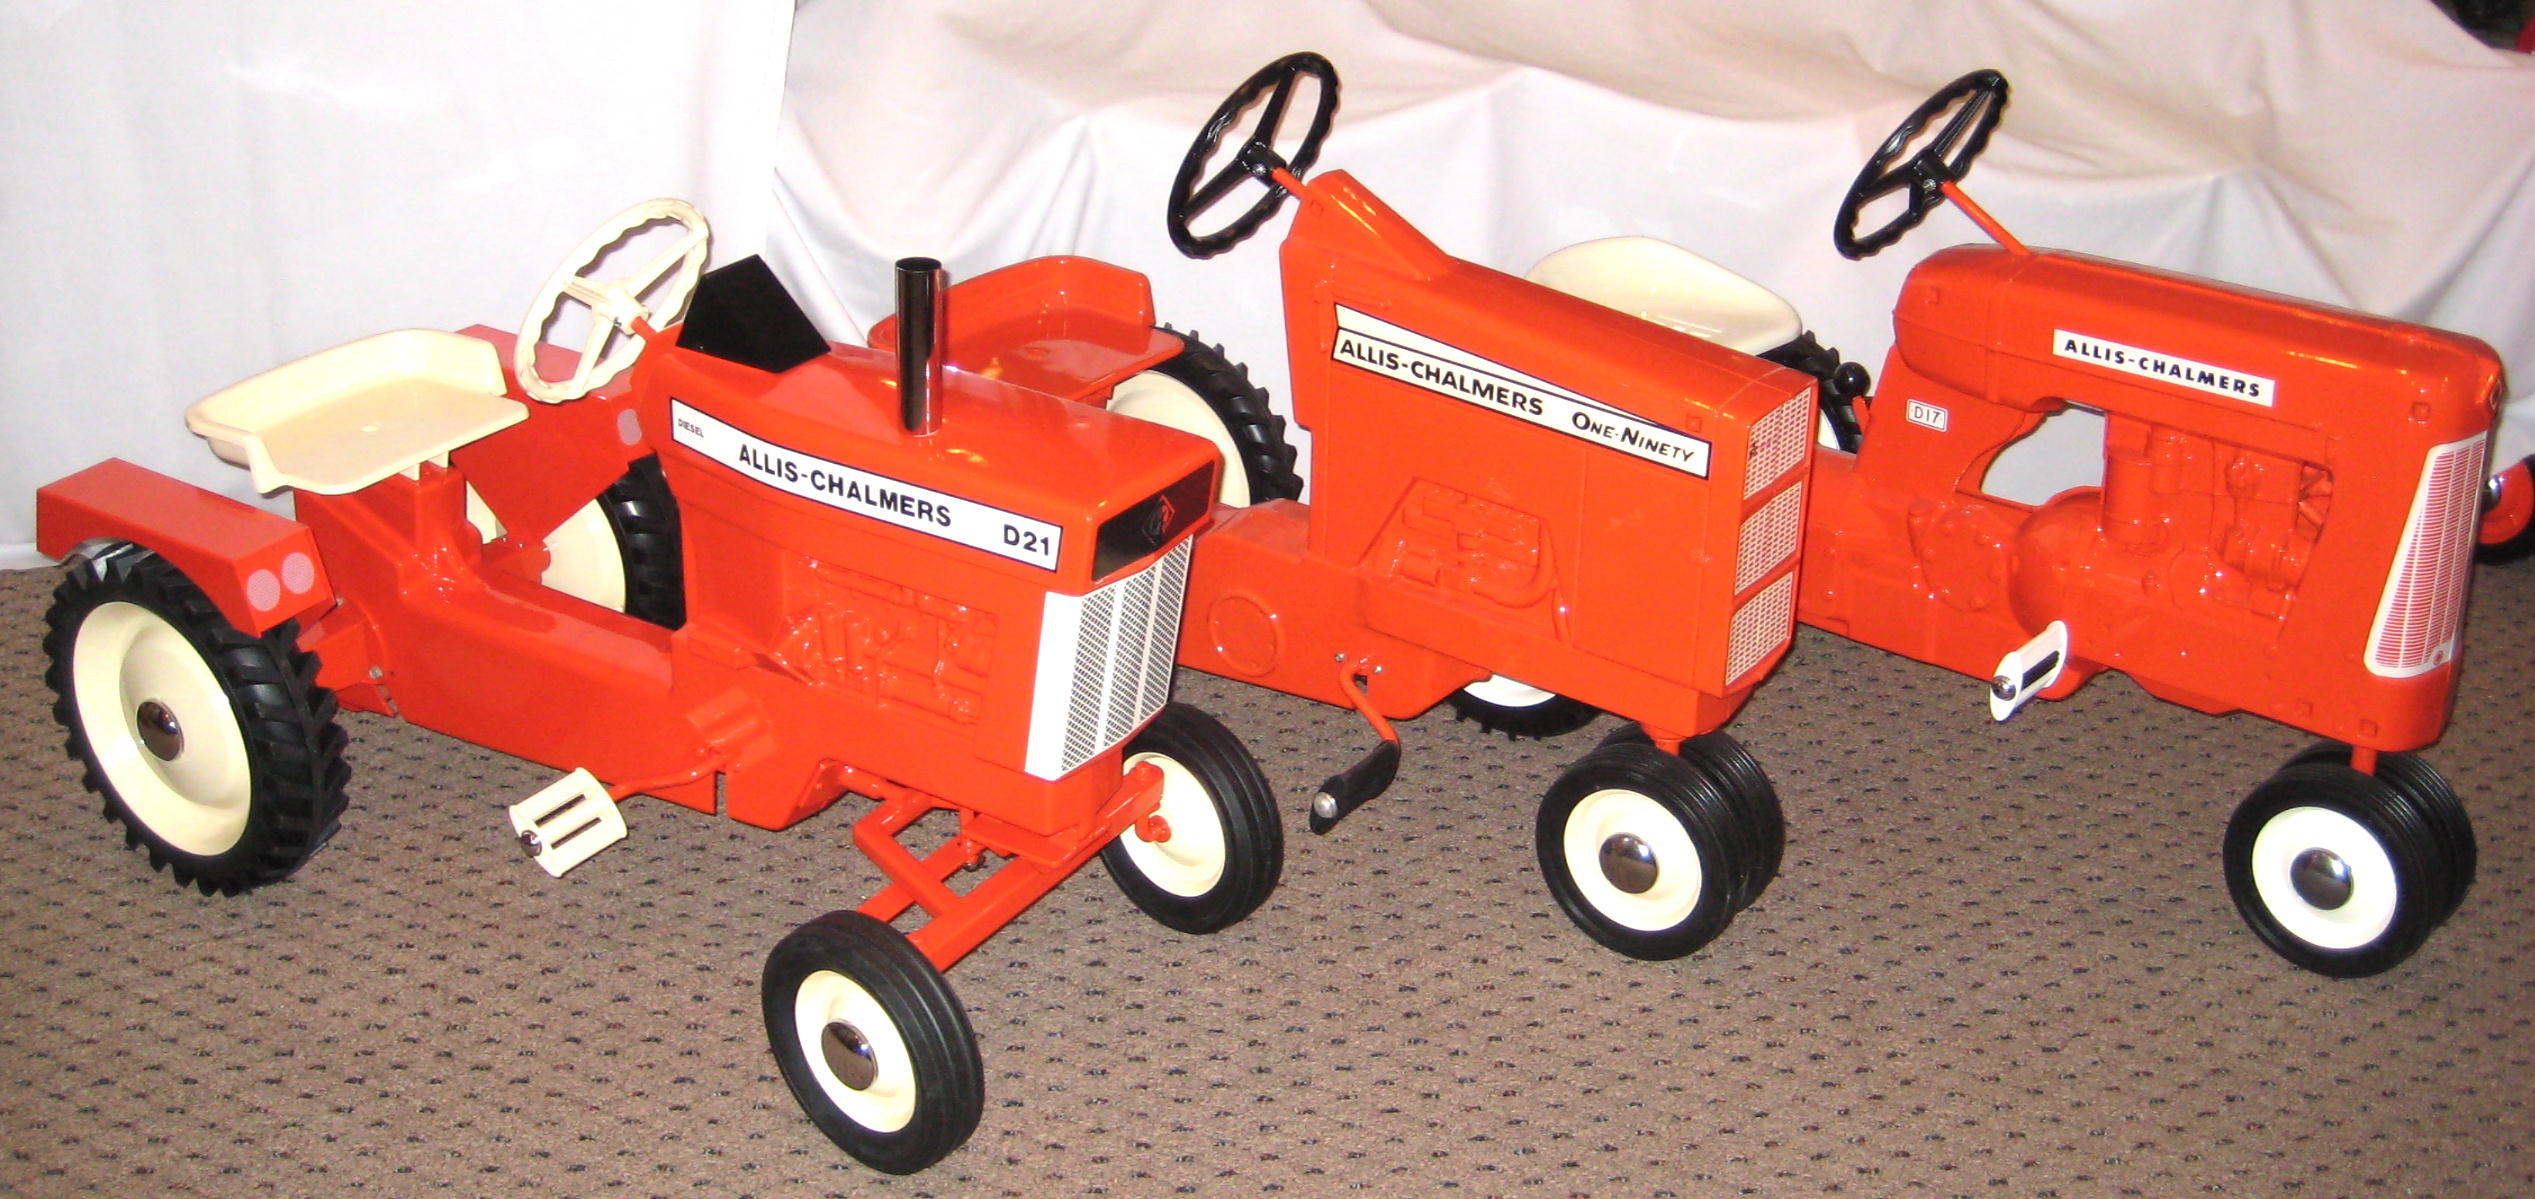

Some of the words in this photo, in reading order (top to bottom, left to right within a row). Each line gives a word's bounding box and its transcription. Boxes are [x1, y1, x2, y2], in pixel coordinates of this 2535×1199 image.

[1339, 338, 1544, 416] ALLIS-CHALMERS
[2064, 338, 2261, 398] ALLIS-CHALMERS
[1914, 405, 1941, 424] D17
[677, 418, 704, 438] DIESEL
[739, 444, 952, 528] ALLIS-CHALMERS
[1003, 524, 1050, 556] D21
